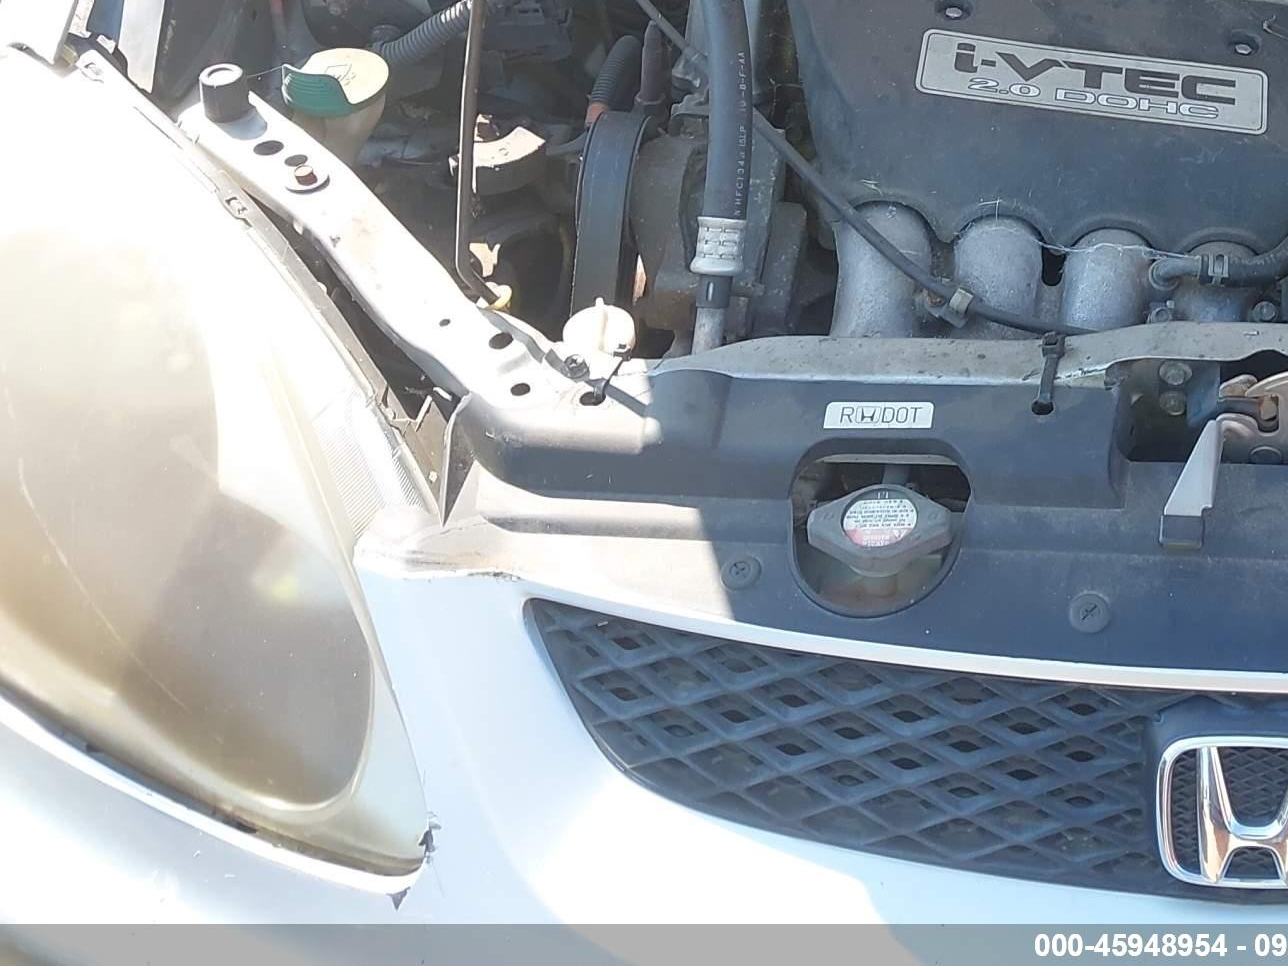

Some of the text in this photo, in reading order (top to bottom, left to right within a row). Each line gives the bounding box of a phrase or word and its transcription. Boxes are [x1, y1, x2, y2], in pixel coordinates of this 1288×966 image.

[953, 41, 1238, 105] i-VTEC
[967, 77, 1220, 120] 2.0 DOHC
